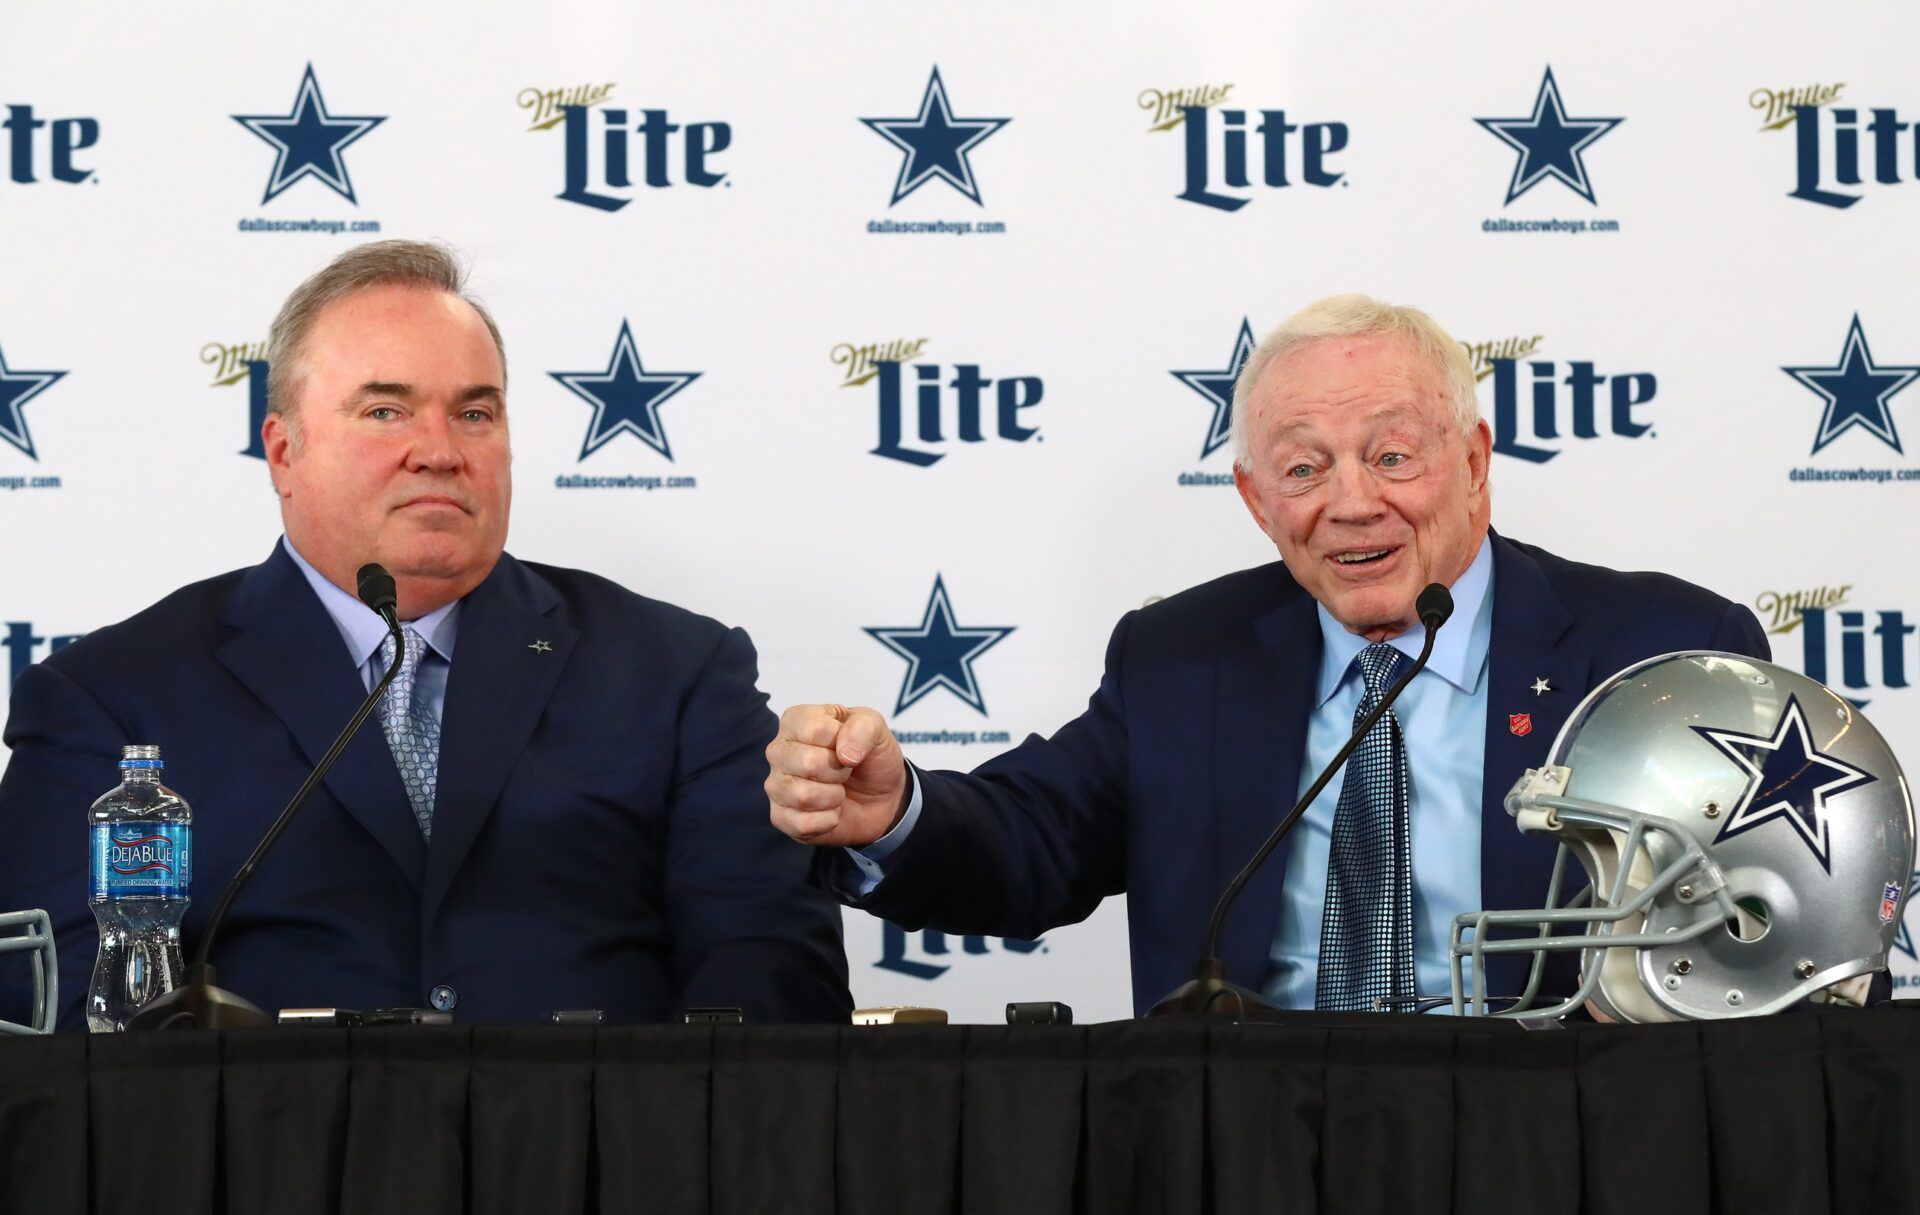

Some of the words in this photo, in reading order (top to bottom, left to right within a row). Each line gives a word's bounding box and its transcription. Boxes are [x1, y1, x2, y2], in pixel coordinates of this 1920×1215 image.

[516, 83, 617, 131] Miller
[1137, 84, 1234, 133] Miller
[1749, 83, 1845, 131] Miller
[554, 105, 732, 213] Lite
[1173, 105, 1349, 213] Lite
[1787, 104, 1920, 210] Lit
[238, 218, 381, 235] dallascowboys.com
[866, 219, 1006, 235] dallascowboys.com
[1481, 218, 1619, 234] dallascowboys.com
[199, 342, 268, 387] Mil
[830, 338, 928, 387] Miller
[868, 360, 1044, 468] Lite
[1489, 358, 1657, 464] Lite
[555, 474, 697, 491] dallascowboys.com
[1756, 585, 1852, 635] Miller
[892, 729, 1011, 745] ascowboys.com
